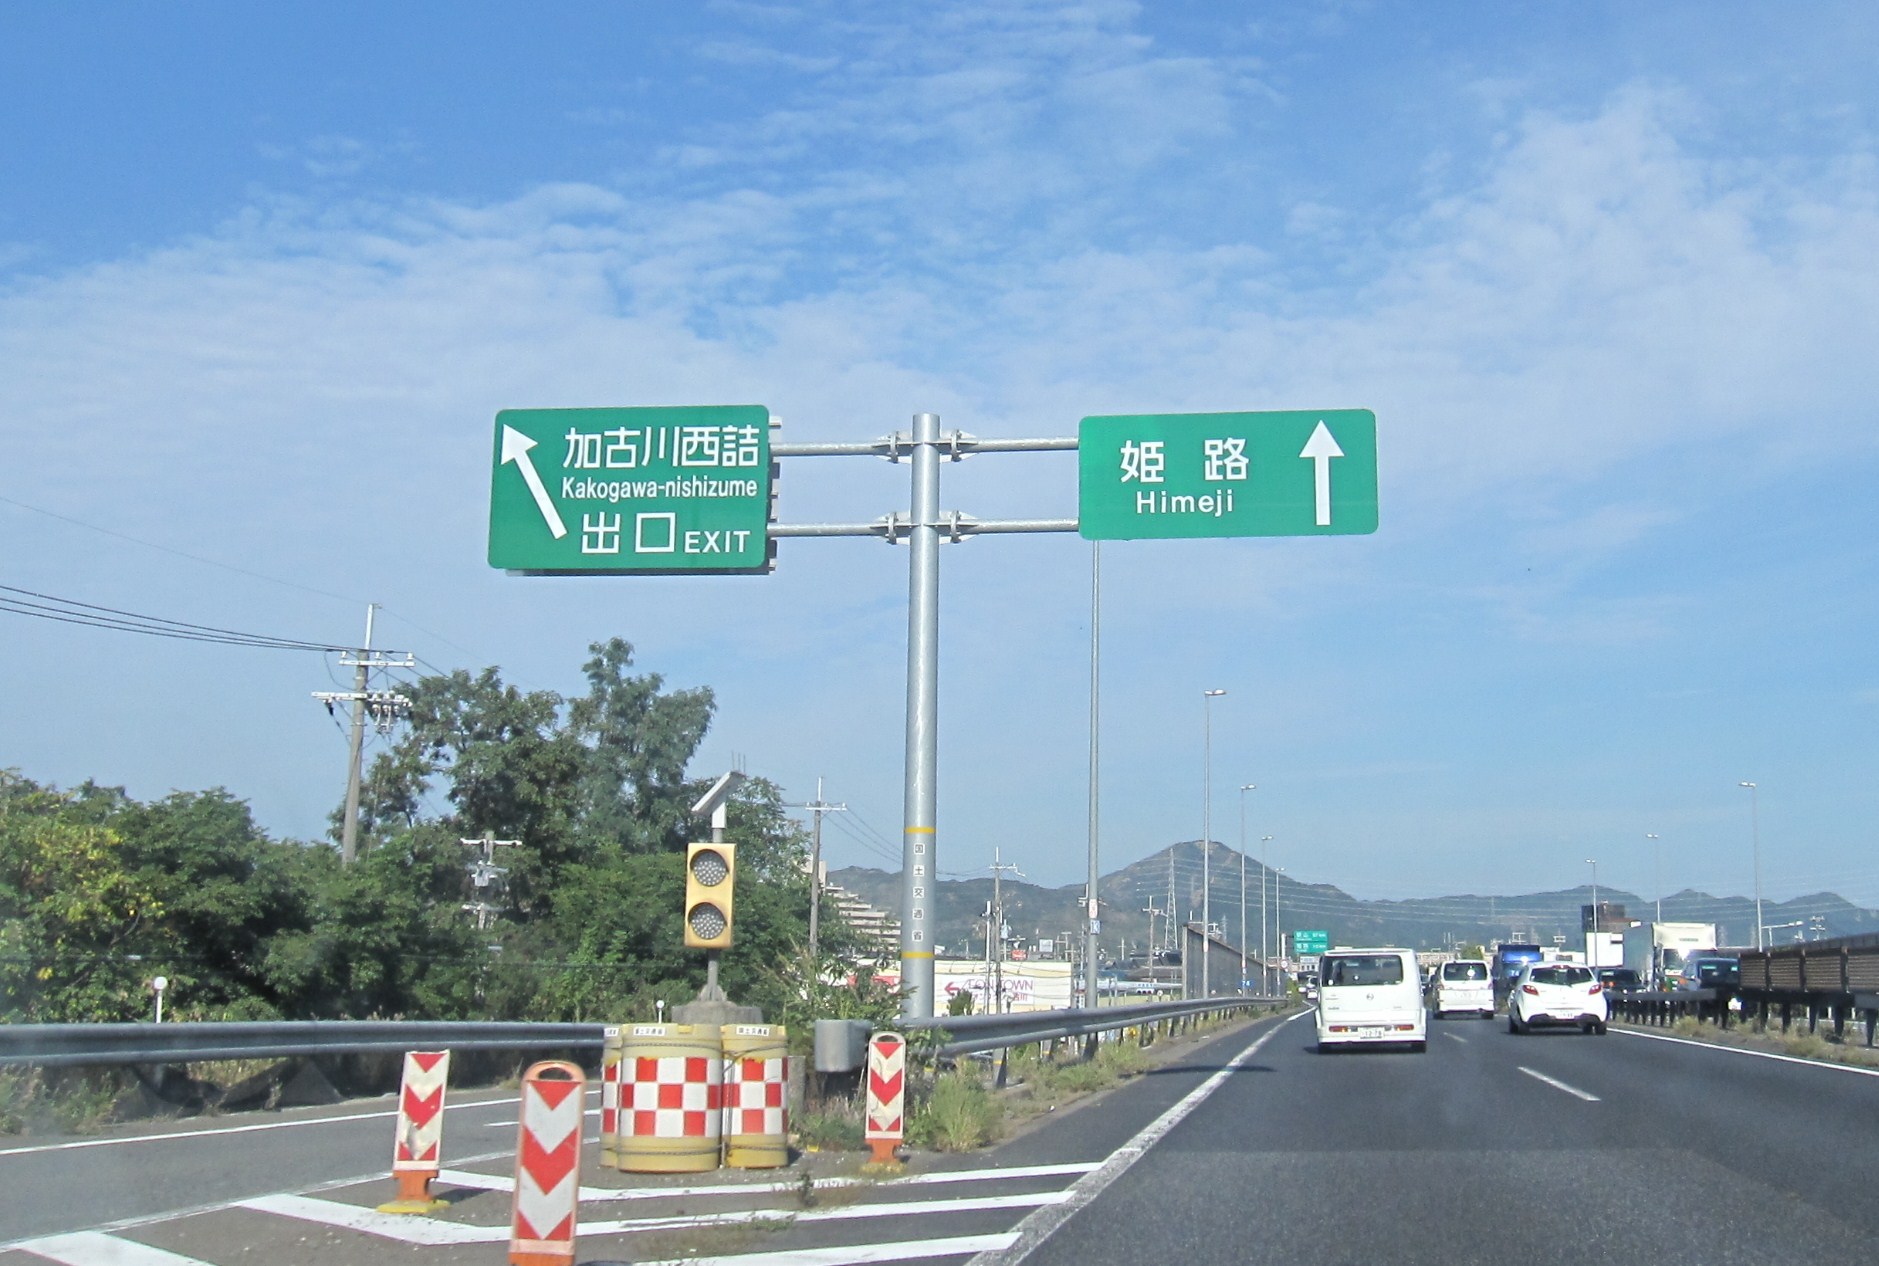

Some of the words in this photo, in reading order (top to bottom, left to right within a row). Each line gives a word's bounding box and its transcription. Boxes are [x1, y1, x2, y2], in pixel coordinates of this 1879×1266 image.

[562, 424, 760, 469] 加古川西詰
[1120, 437, 1249, 483] 姫路
[562, 475, 758, 503] Kakogawa-nishizume
[1136, 489, 1234, 517] Himeji
[581, 511, 676, 554] 出口
[684, 530, 751, 553] EXIT
